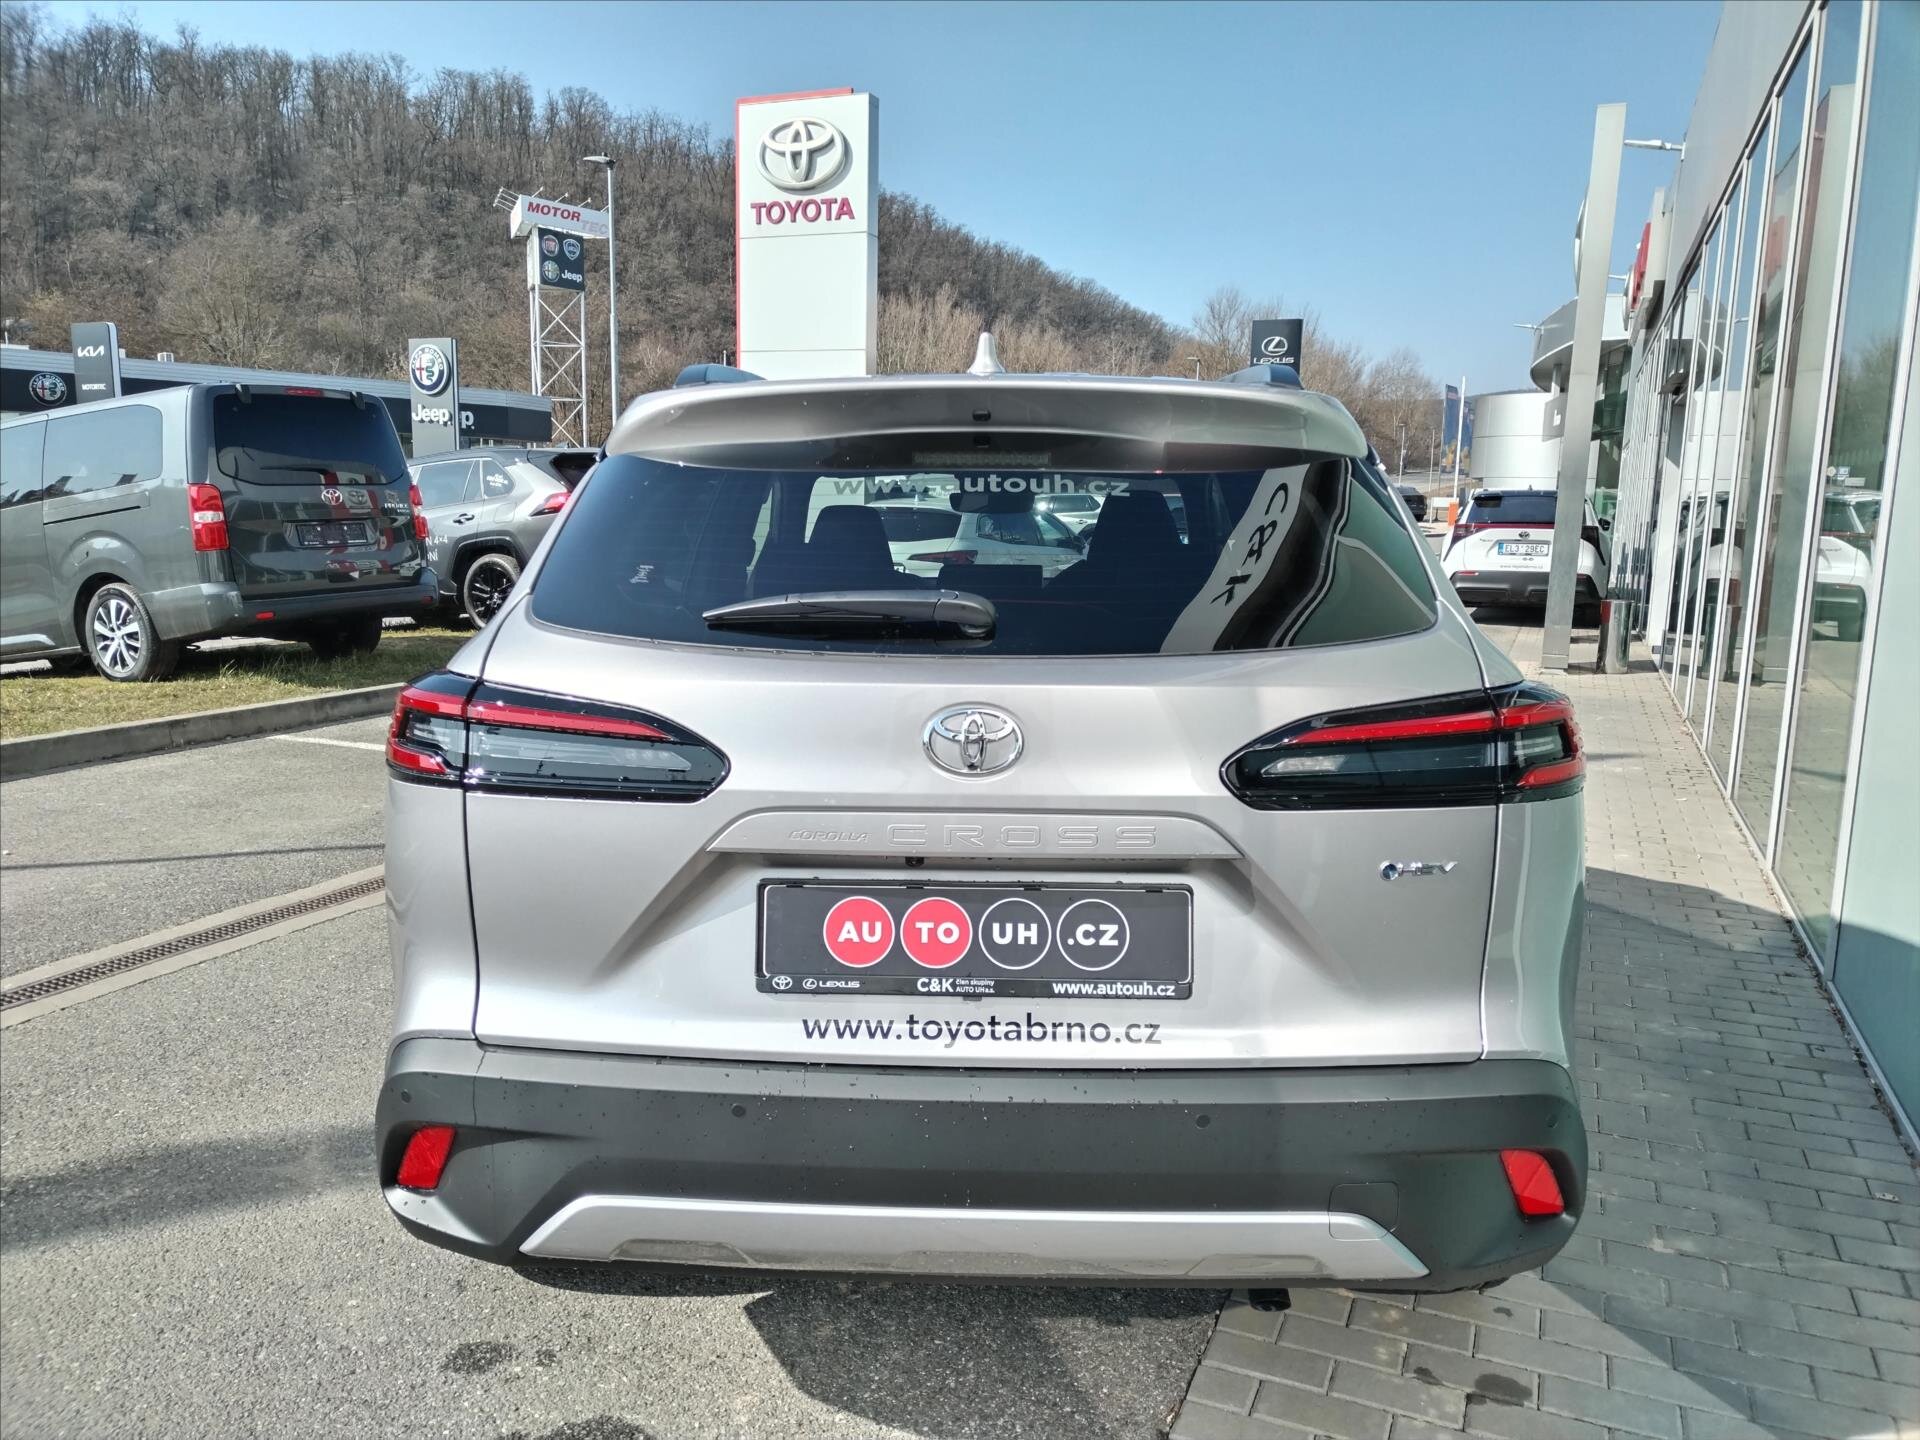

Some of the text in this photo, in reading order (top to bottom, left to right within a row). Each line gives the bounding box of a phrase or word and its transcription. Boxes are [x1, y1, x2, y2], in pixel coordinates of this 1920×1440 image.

[527, 201, 581, 222] MOTOR
[750, 197, 855, 225] TOYOTA
[562, 270, 583, 283] Jeep
[77, 345, 104, 357] KIA
[834, 474, 1131, 497] www.autouh.cz
[788, 823, 1157, 849] COROLLA CROSS
[837, 920, 883, 943] AU
[915, 921, 961, 944] TO
[992, 922, 1038, 945] UH
[819, 980, 861, 989] LEXUS
[917, 977, 954, 993] C&K
[970, 979, 995, 987] skupiny
[1052, 981, 1176, 996] www.autouh.cz
[801, 1012, 1163, 1049] www.toyotabrno.cz
